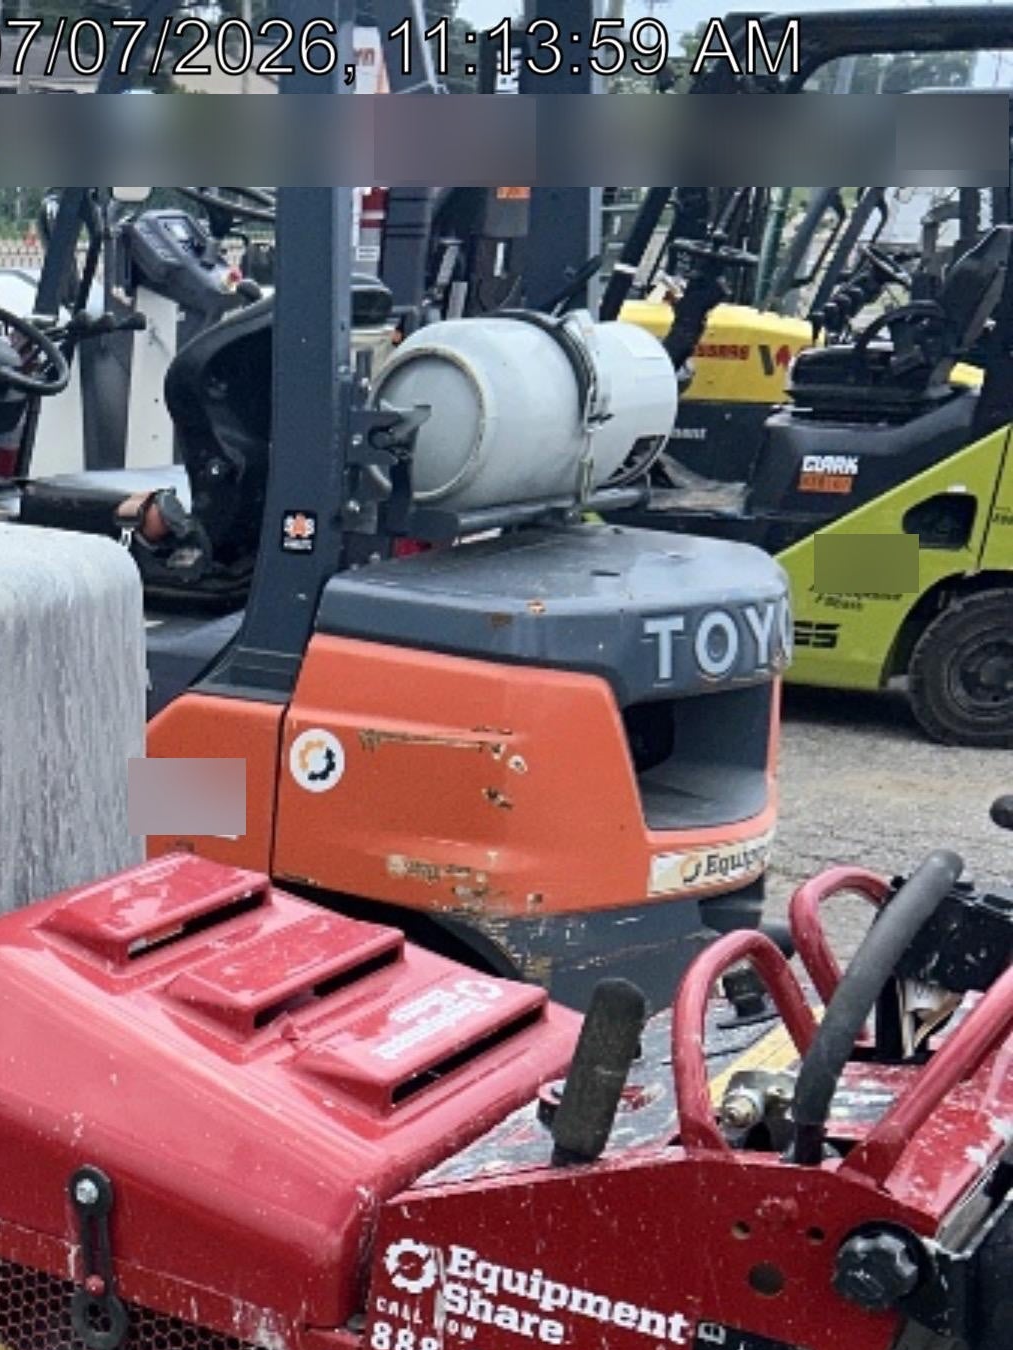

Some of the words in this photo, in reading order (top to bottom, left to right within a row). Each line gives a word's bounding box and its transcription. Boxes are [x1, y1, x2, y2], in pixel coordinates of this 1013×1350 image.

[375, 1296, 423, 1325] CALL
[443, 1281, 565, 1345] Share
[446, 1244, 690, 1345] Equipment
